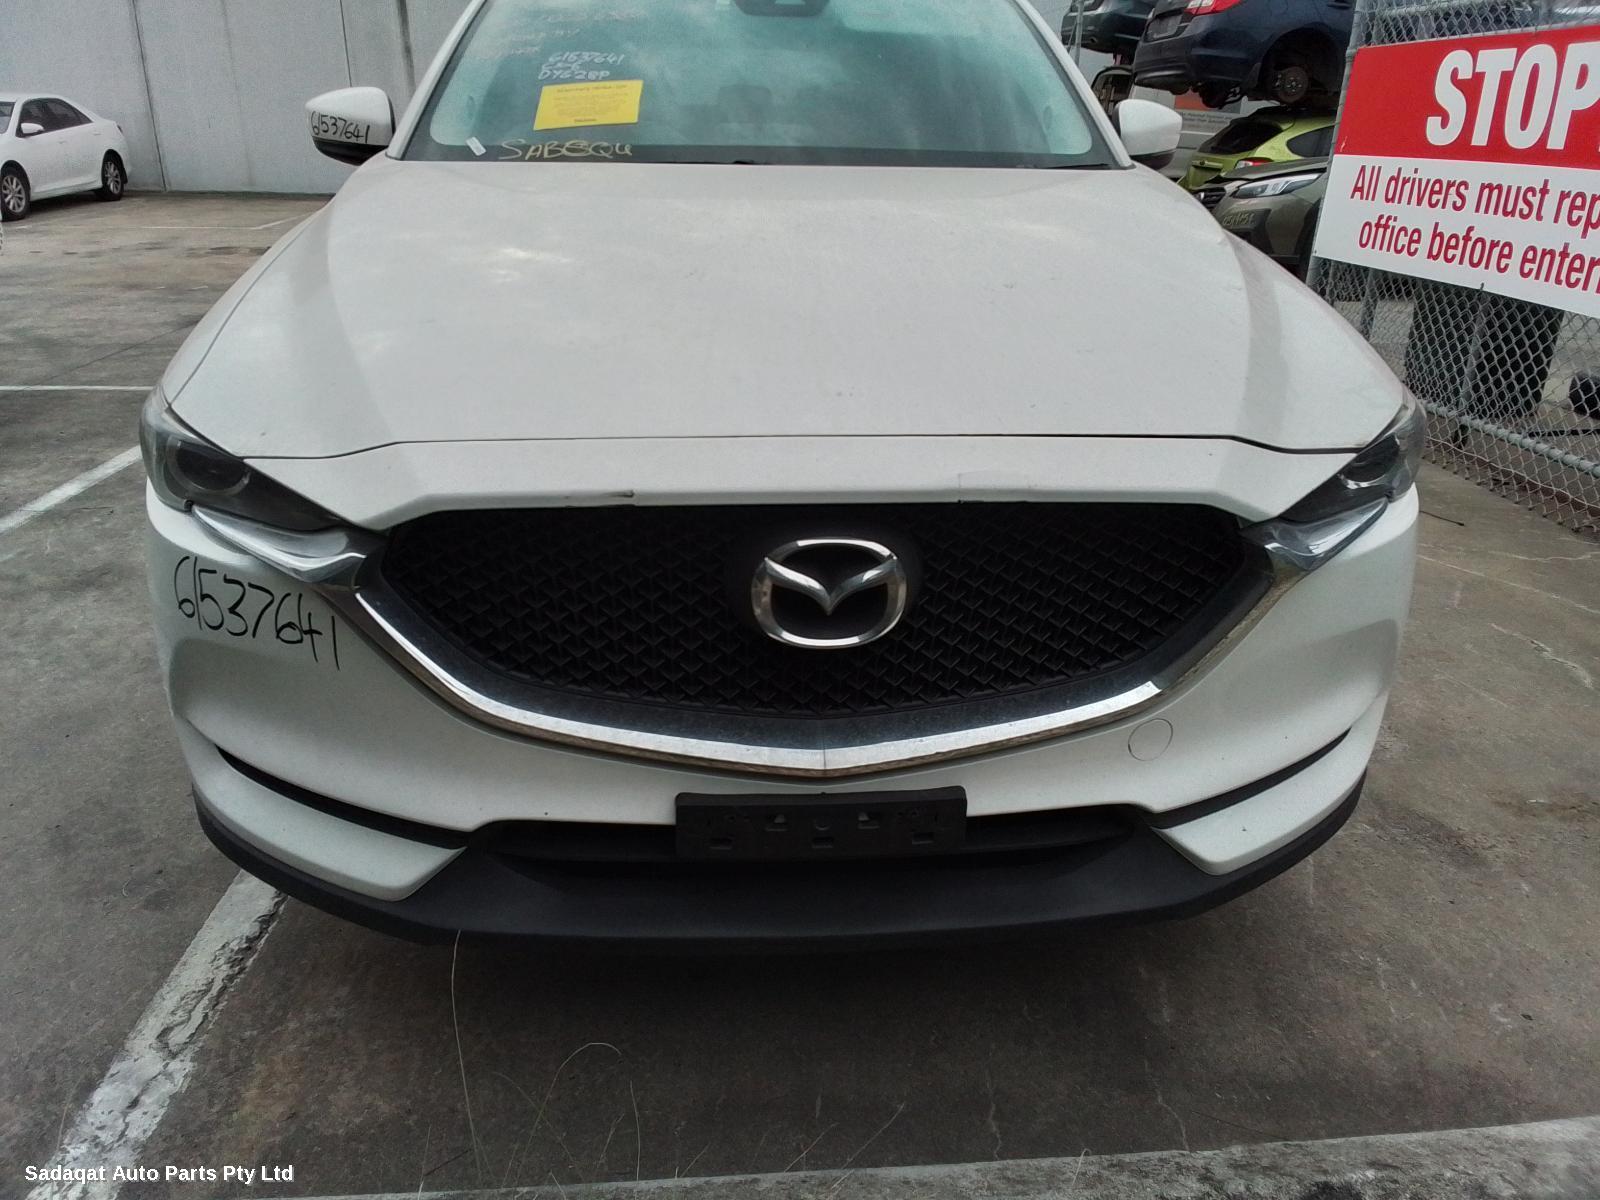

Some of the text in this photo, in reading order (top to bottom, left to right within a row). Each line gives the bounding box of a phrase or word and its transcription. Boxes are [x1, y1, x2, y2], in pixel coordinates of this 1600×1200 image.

[548, 51, 625, 65] 61537641
[1425, 40, 1600, 151] STOP
[311, 110, 371, 144] 61537641
[1350, 164, 1600, 239] All drivers must rep
[1358, 214, 1600, 295] office before enter
[174, 555, 340, 672] 61537641
